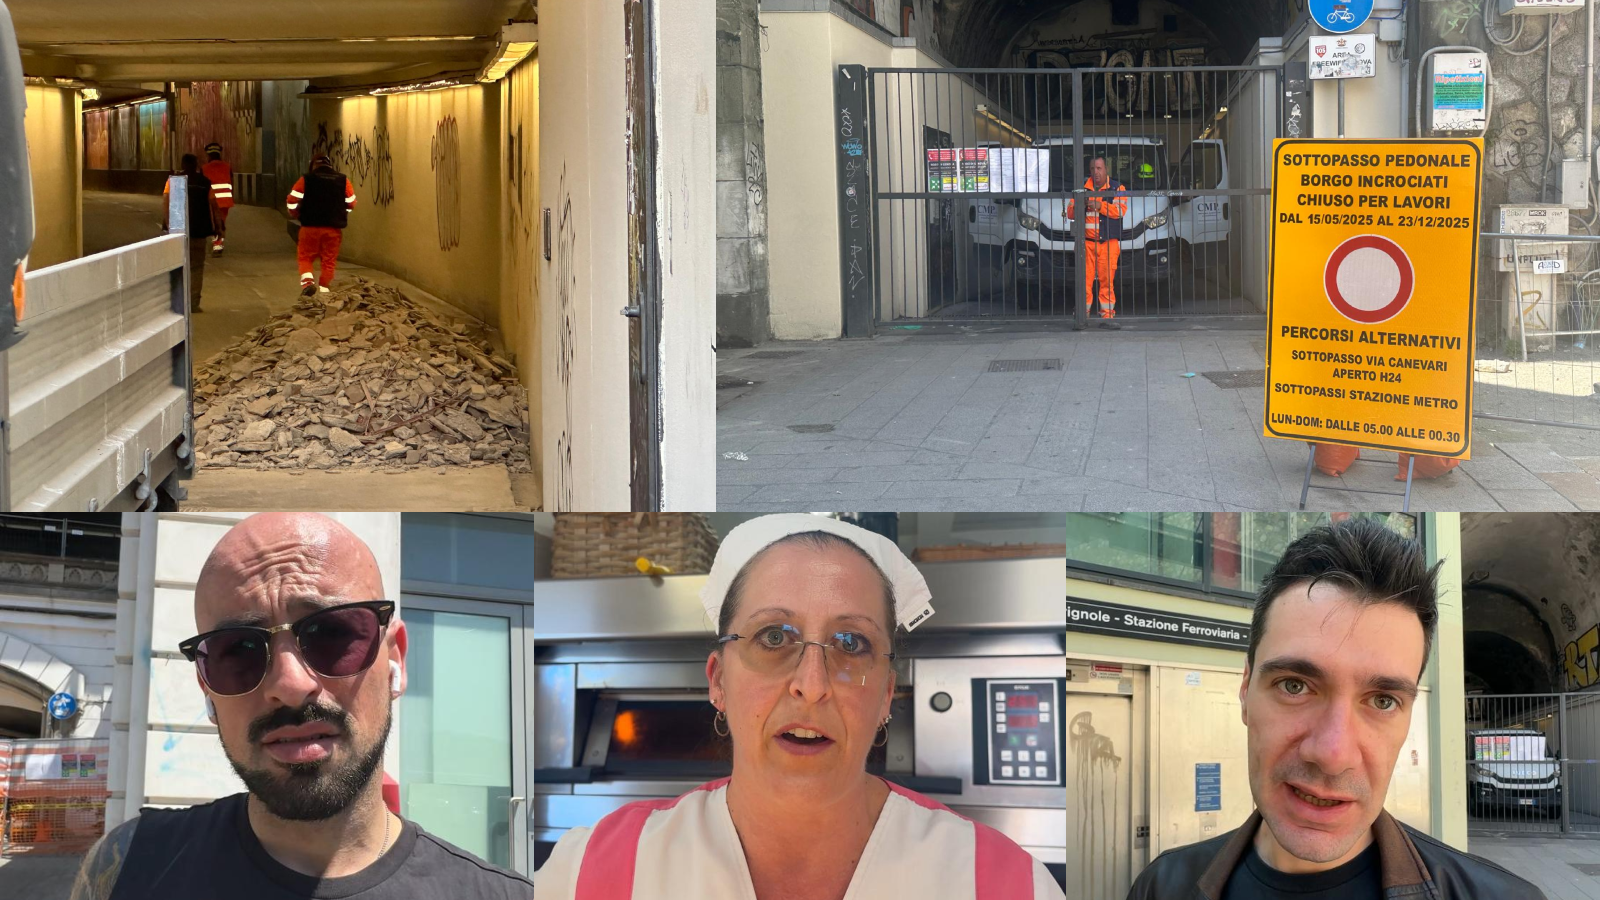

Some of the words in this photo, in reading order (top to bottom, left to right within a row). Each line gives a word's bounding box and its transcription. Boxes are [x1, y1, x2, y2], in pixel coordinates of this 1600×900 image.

[1435, 75, 1483, 84] Ripetizioni
[1284, 154, 1380, 166] SOTTOPASSO
[1386, 155, 1470, 167] PEDONALE
[1301, 174, 1352, 187] BORGO
[1358, 175, 1447, 188] INCROCIATI
[1298, 194, 1353, 207] CHIUSO
[1359, 195, 1388, 207] PER
[1394, 196, 1450, 209] LAVORI
[1280, 213, 1302, 223] DAL
[1308, 214, 1373, 225] 15/05/2025
[1377, 216, 1393, 226] AL
[1398, 216, 1469, 228] 23/12/2025
[1282, 326, 1353, 342] PERCORSI
[1359, 331, 1460, 349] ALTERNATIVI
[1292, 350, 1362, 364] SOTTOPASSO
[1366, 356, 1385, 366] VIA
[1389, 357, 1447, 371] CANEVARI
[1333, 368, 1376, 381] APERTO
[1380, 372, 1401, 383] H24
[1275, 383, 1345, 398] SOTTOPASSI
[1350, 390, 1409, 404] STAZIONE
[1414, 396, 1458, 409] METRO
[1272, 413, 1322, 428] LUN-DOM:
[1326, 419, 1359, 432] DALLE
[1364, 423, 1393, 435] 05.00
[1397, 427, 1425, 439] ALLE
[1429, 430, 1460, 442] 00.30
[1066, 606, 1111, 622] ignole
[1124, 614, 1179, 632] Stazione
[1182, 622, 1240, 640] Ferroviaria
